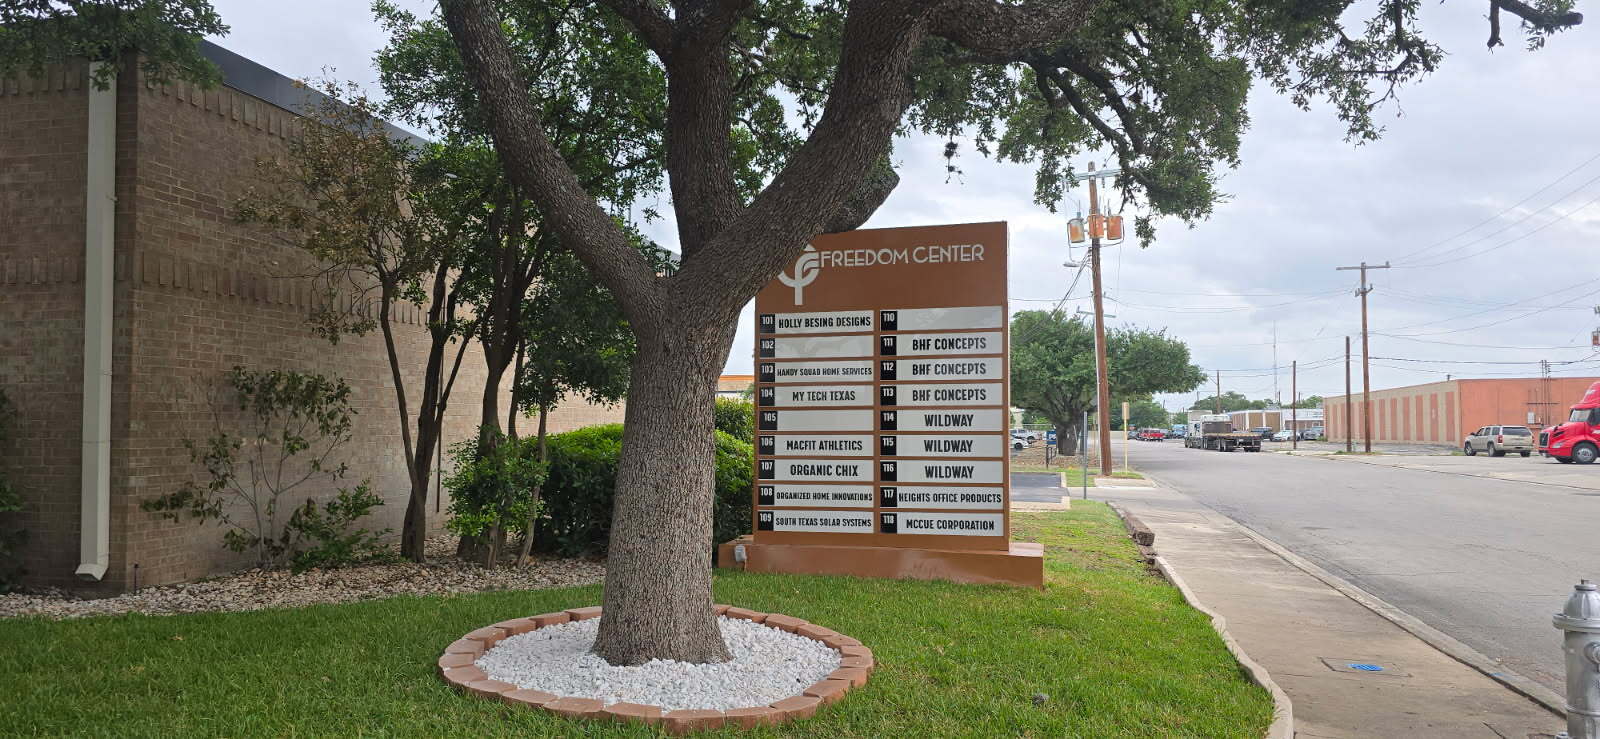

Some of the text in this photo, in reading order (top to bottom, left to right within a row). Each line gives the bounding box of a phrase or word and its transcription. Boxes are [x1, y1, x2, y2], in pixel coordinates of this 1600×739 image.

[820, 244, 985, 268] FREEDOM CENTER
[762, 315, 871, 329] 101 HOLLY BESING DESIGNS
[882, 313, 895, 322] 110
[761, 340, 774, 349] 102
[883, 337, 986, 351] 111 BHF CONCEPTS
[761, 365, 872, 377] 103 HANDY SQUAD HOME SERVICES
[882, 362, 986, 376] 112 BHF CONCEPTS
[761, 389, 856, 402] 104 MY TECH TEXAS
[882, 388, 986, 401] 113 BHF CONCEPTS
[764, 413, 776, 421] 105
[883, 412, 974, 427] 114 WILDWAY
[761, 438, 863, 451] 106 MACFIT ATHLETICS
[882, 438, 973, 452] 115 WILDWAY
[761, 461, 859, 476] 107 ORGANIC CHIX
[883, 464, 974, 478] 116 WILDWAY
[760, 487, 873, 501] 108 ORGANIZED HOME INNOVATIONS
[884, 489, 1002, 503] 117 HEIGHTS OFFICE PRODUCTS
[760, 513, 872, 527] 109 SOUTH TEXAS SOLAR SYSTEMS
[883, 515, 995, 530] 118 MCCUE CORPORATION
